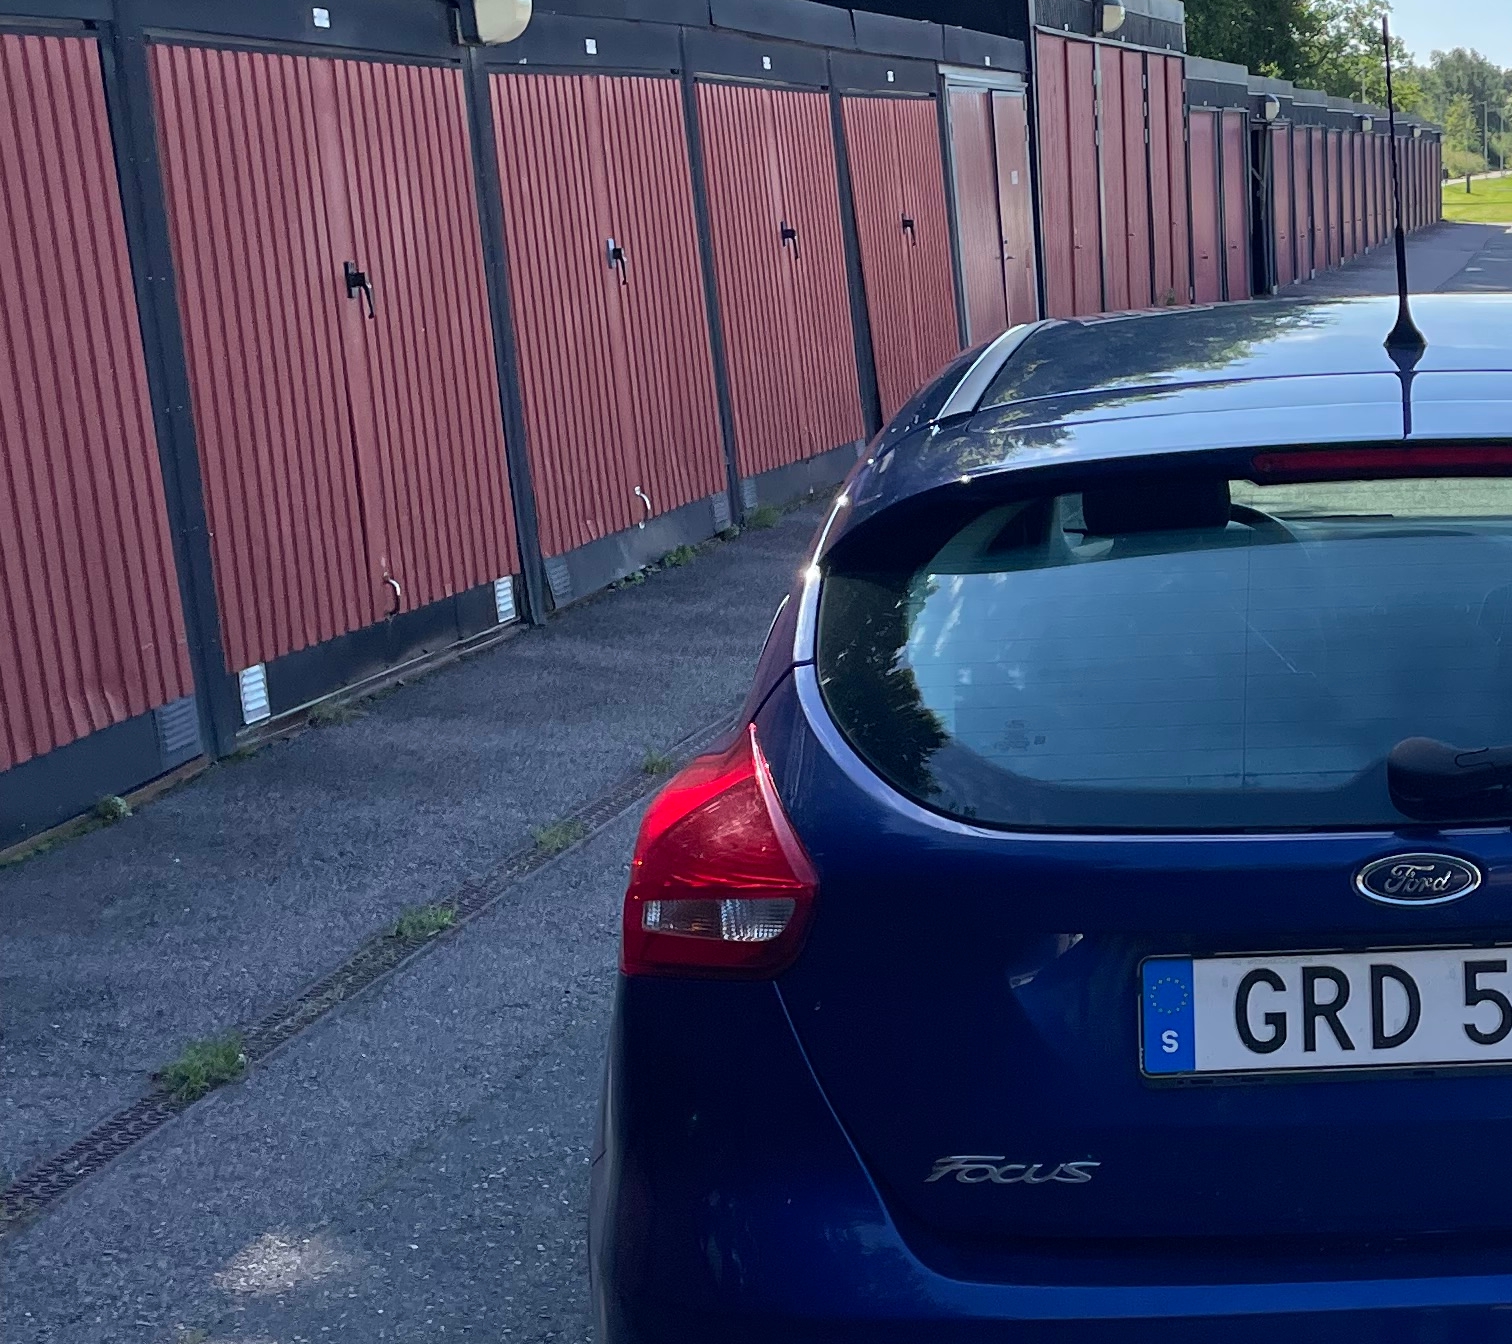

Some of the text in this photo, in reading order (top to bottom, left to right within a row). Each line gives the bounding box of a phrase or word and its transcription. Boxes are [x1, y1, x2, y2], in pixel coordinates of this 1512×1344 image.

[1384, 864, 1452, 893] Ford
[1235, 964, 1421, 1054] GRD
[1162, 1030, 1179, 1053] S
